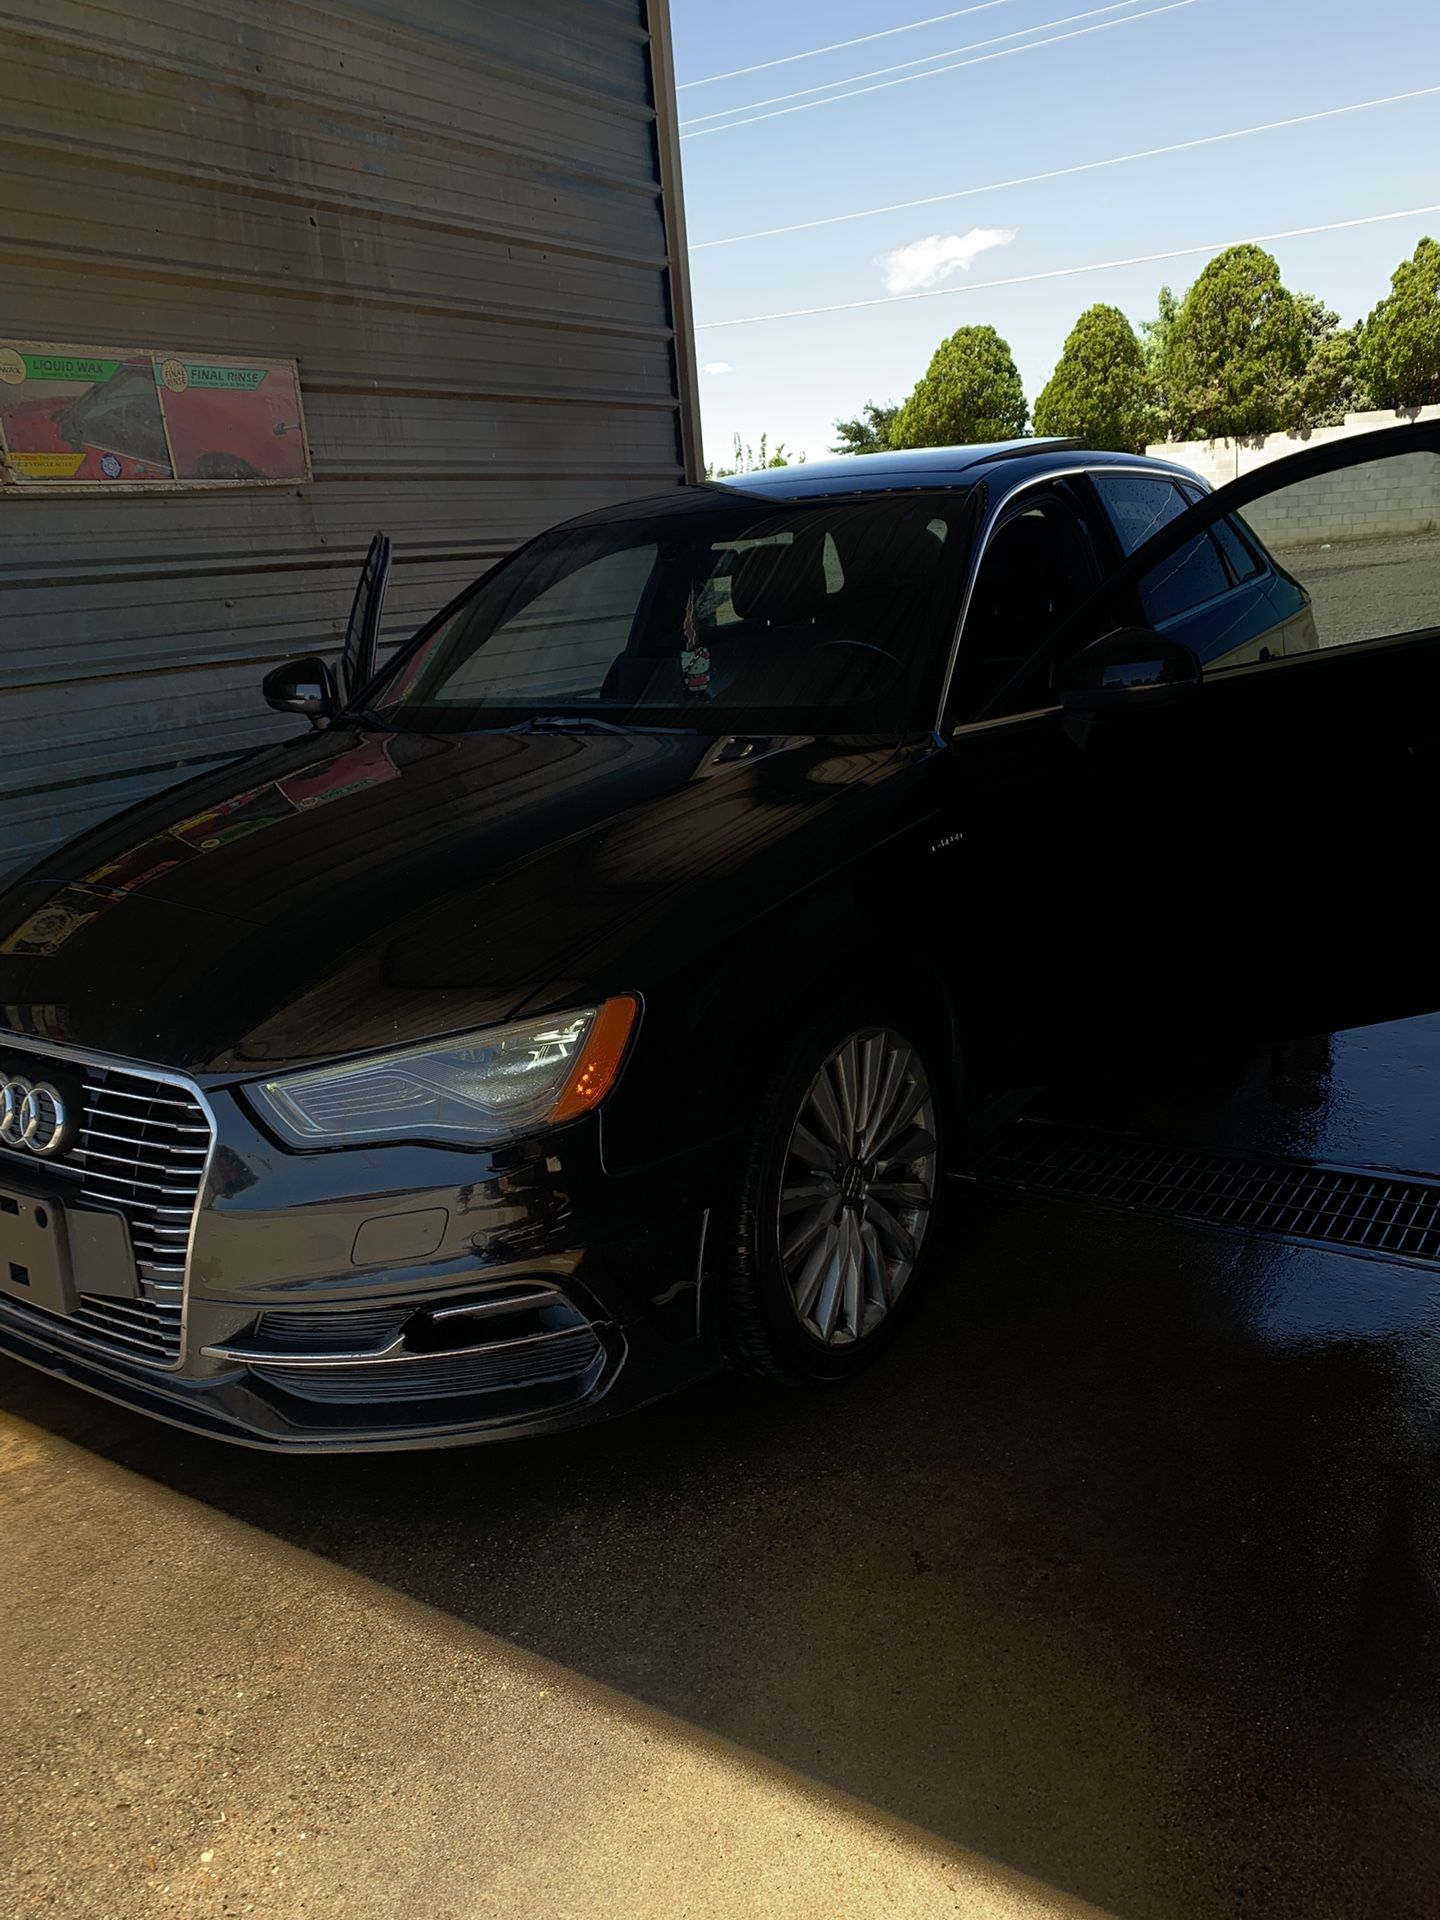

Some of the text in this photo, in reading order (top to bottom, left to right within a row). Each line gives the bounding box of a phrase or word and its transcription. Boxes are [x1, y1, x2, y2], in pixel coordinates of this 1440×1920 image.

[33, 359, 104, 373] LIQUID WAX
[165, 369, 185, 379] FINAL
[191, 369, 258, 383] FINAL RINSE
